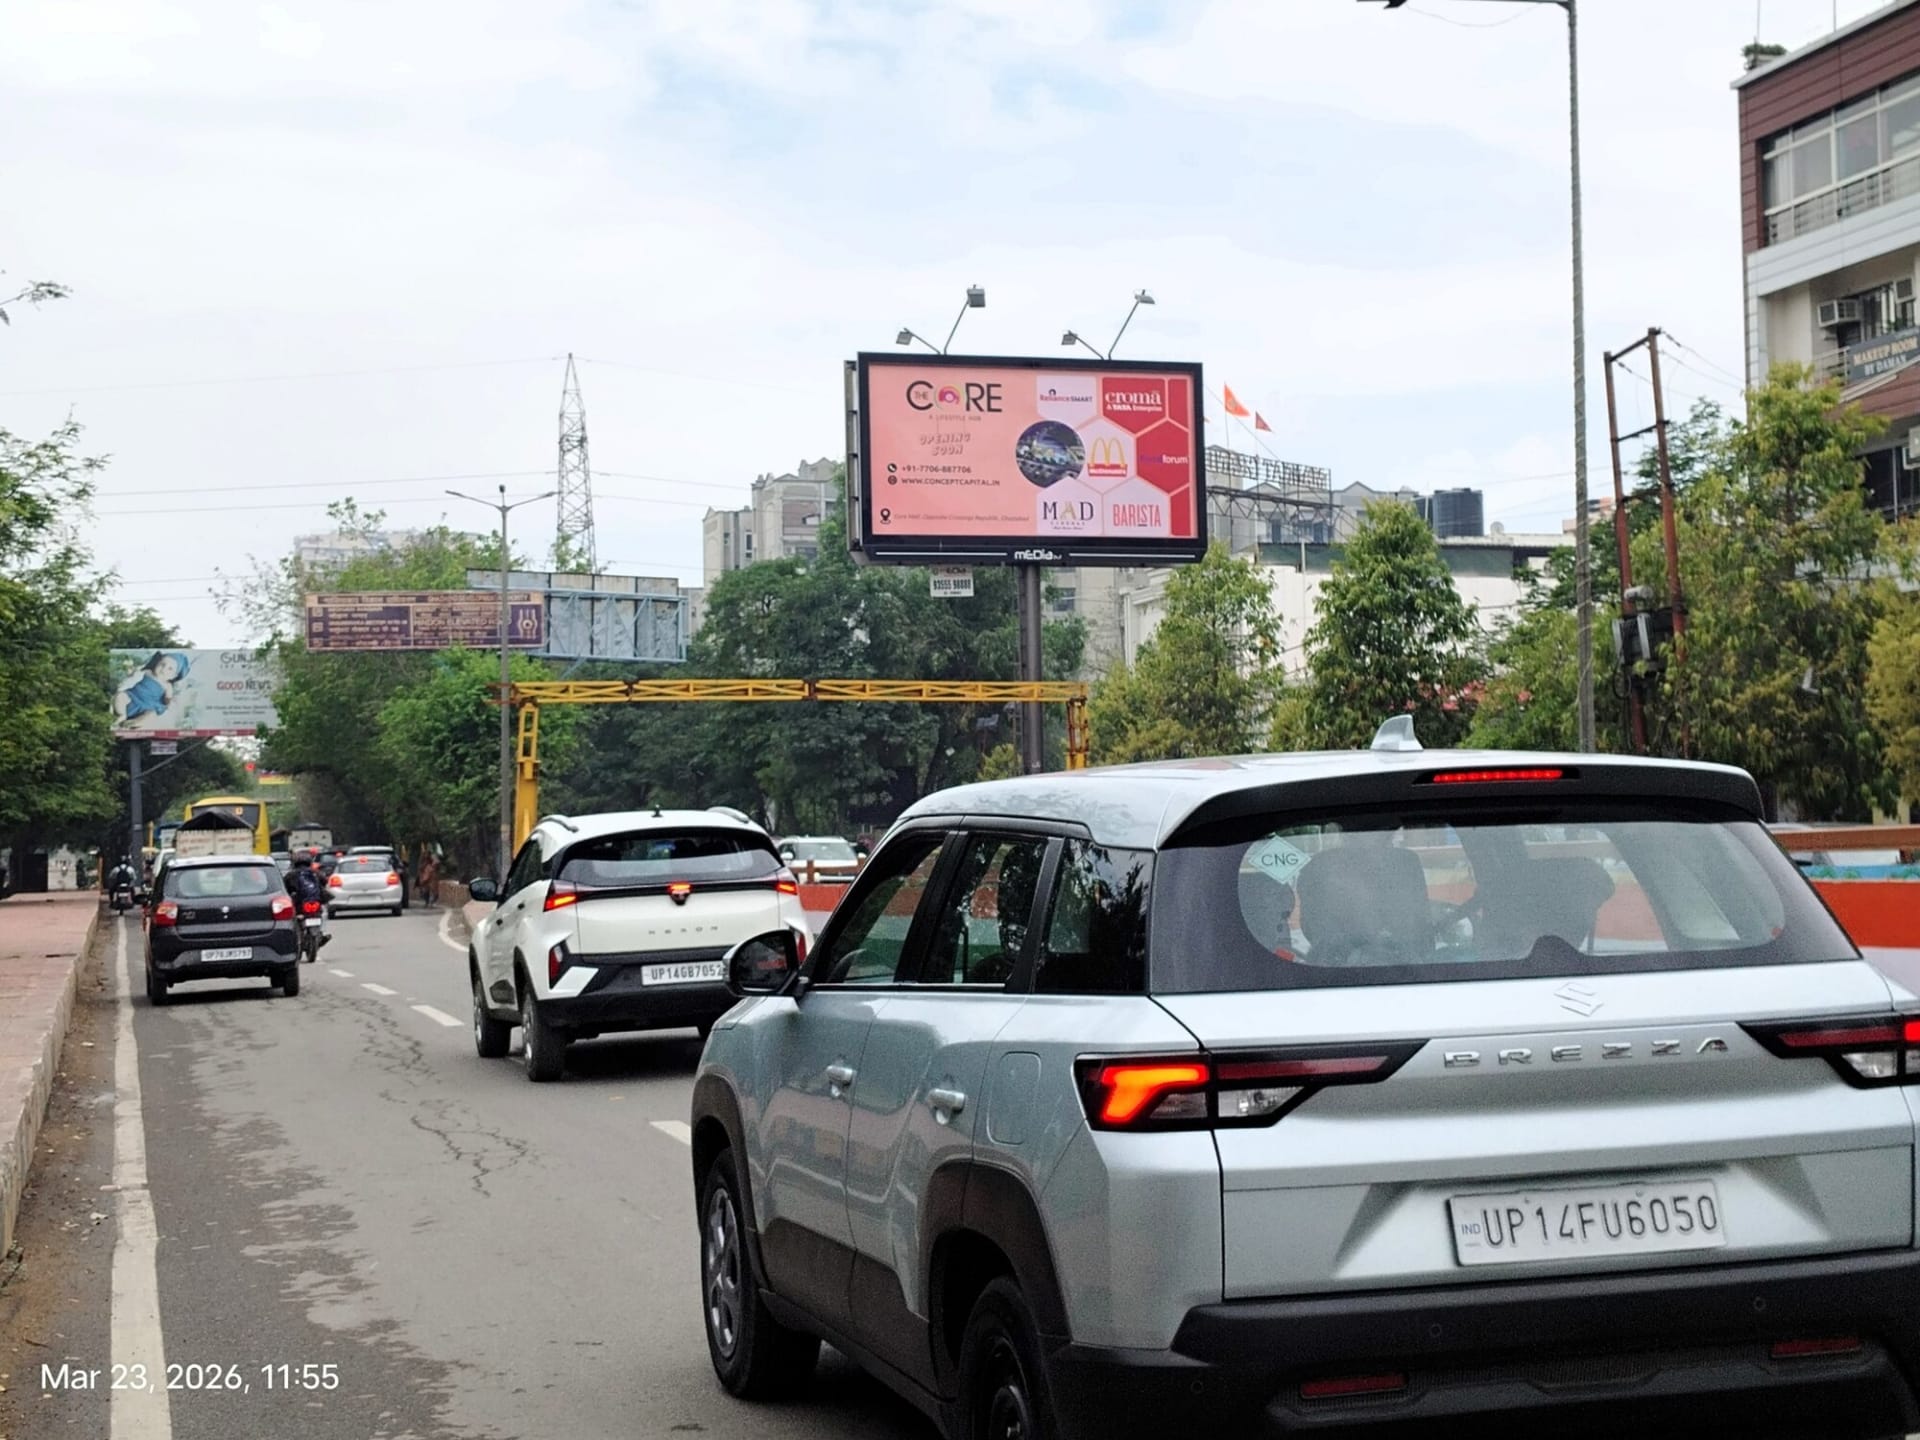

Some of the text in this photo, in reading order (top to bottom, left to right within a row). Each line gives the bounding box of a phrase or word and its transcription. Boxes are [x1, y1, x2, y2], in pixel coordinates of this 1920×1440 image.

[906, 380, 1003, 412] CORE
[1043, 501, 1094, 521] MAD
[1113, 503, 1161, 528] BARISTA
[217, 680, 244, 690] GOOD
[1261, 852, 1299, 867] CNG
[1443, 1037, 1729, 1068] BREZZA
[1461, 1195, 1718, 1247] IND UP14FU6050
